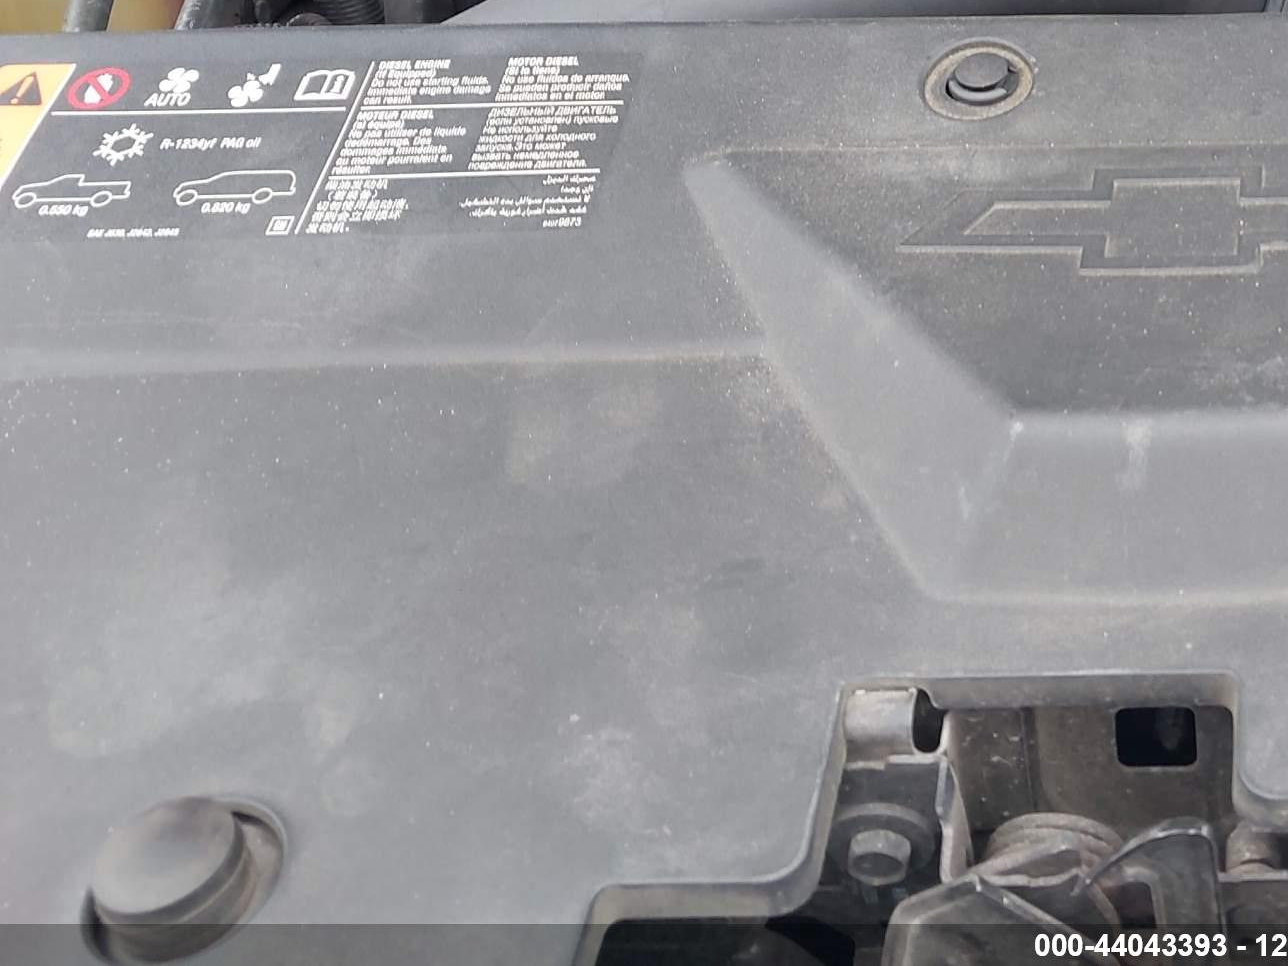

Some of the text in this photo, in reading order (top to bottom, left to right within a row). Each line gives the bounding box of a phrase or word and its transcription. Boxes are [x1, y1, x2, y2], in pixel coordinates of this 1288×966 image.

[379, 59, 451, 69] DIESEL ENGINE
[508, 56, 579, 66] MOTOR DIESEL
[144, 92, 191, 107] AUTO
[357, 109, 434, 120] MOTEUR DIESEL
[160, 137, 262, 151] R-1234yf PAG oil
[72, 204, 89, 217] kg
[235, 201, 251, 214] kg
